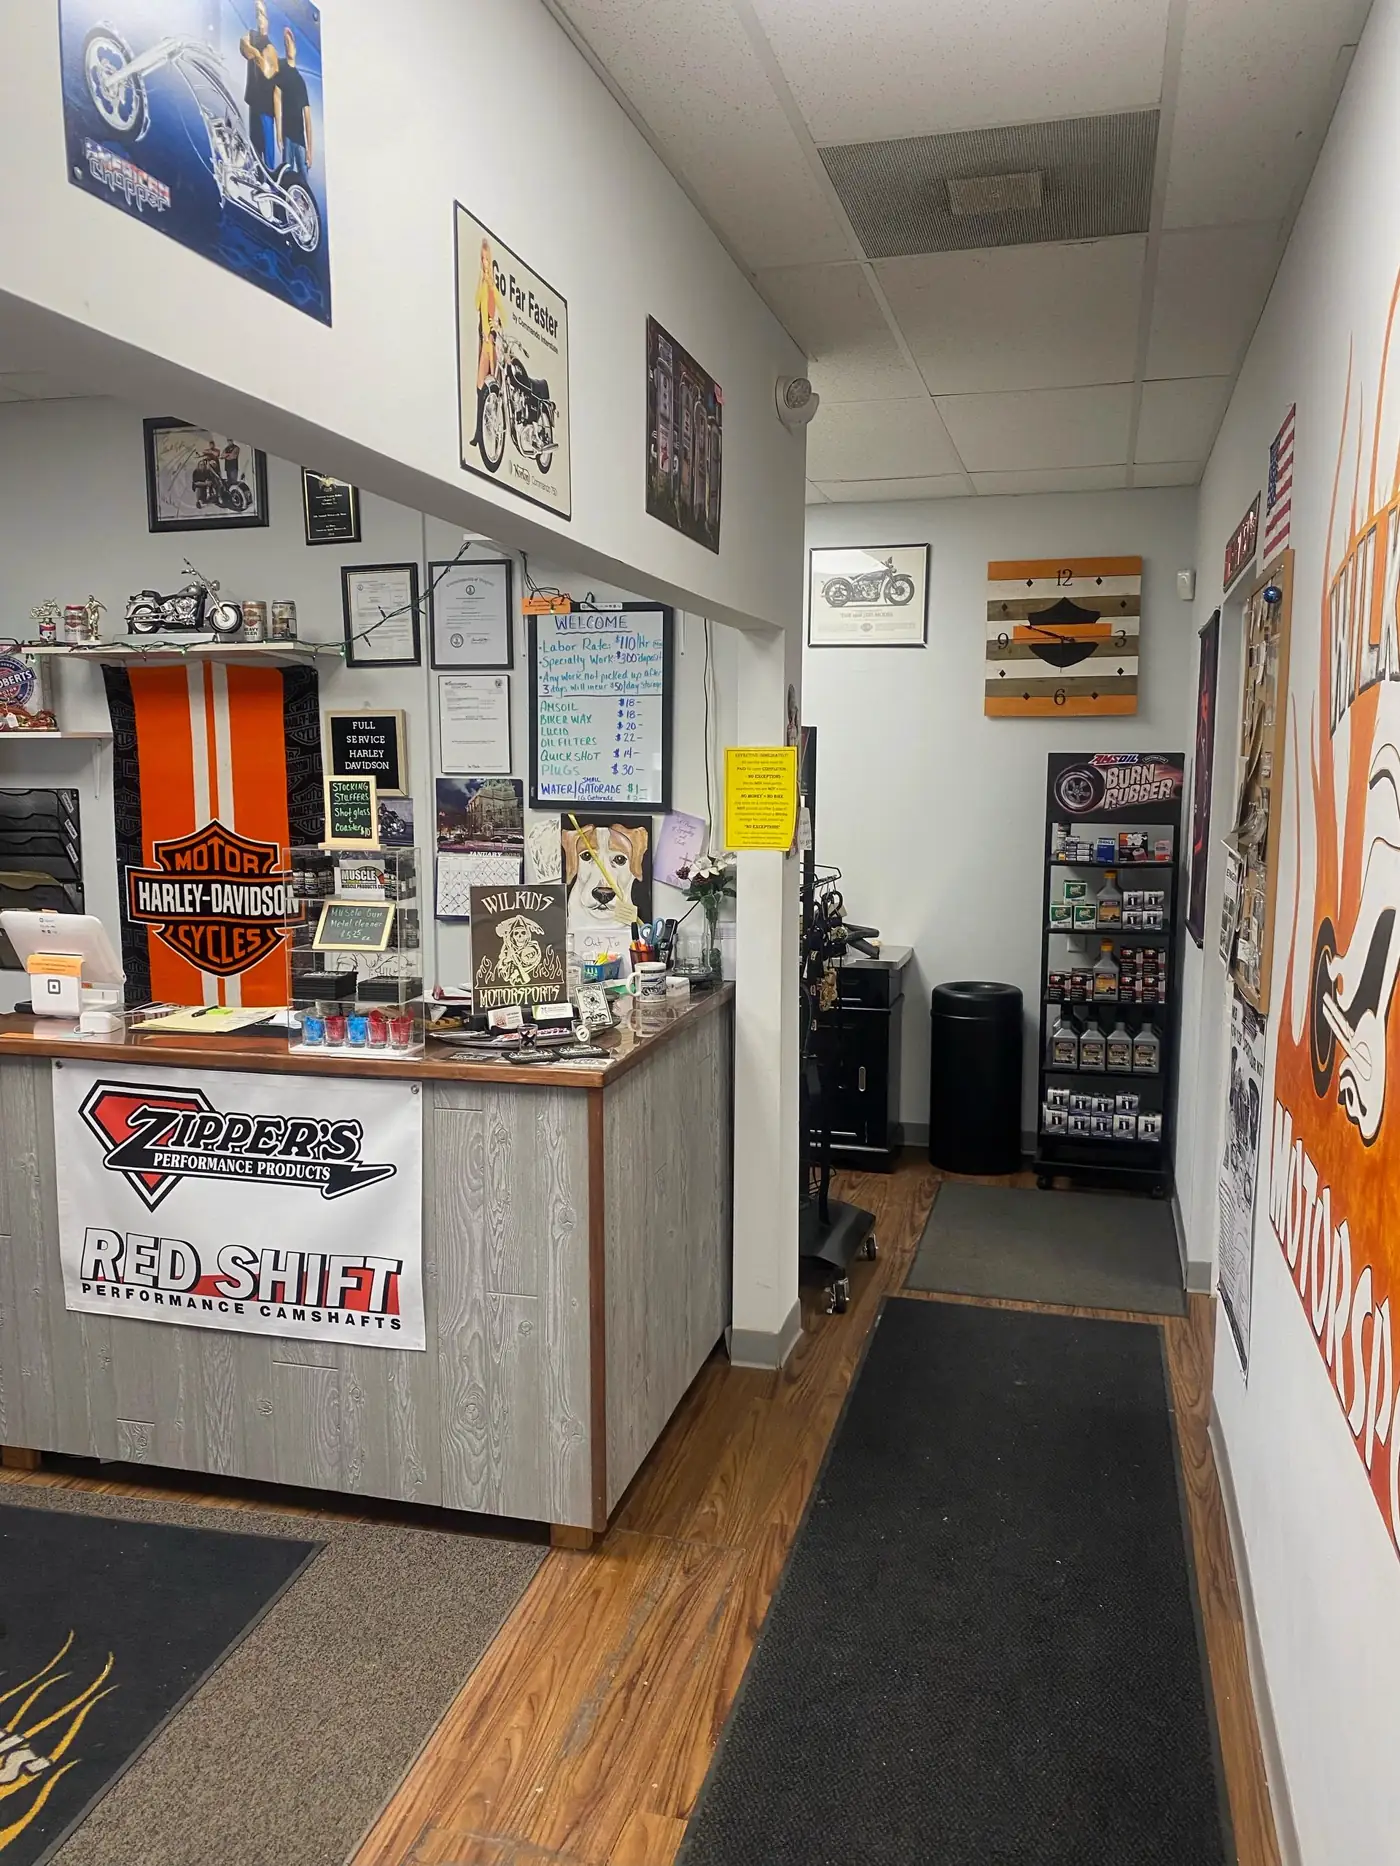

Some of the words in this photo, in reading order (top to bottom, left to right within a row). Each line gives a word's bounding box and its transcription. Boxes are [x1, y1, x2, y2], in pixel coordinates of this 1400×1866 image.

[492, 259, 506, 297] Go
[509, 274, 526, 313] Far
[528, 290, 558, 339] Faster
[1056, 567, 1073, 587] 12
[555, 615, 628, 631] WELCOME
[543, 639, 577, 653] Labor
[997, 632, 1010, 650] 9
[1114, 630, 1126, 648] 3
[542, 654, 585, 673] Specialty
[584, 670, 598, 680] not
[601, 669, 628, 683] picked
[631, 671, 642, 681] up
[543, 684, 550, 694] 3
[1054, 688, 1066, 706] 6
[540, 700, 578, 713] AMSOIL
[352, 721, 376, 730] FULL
[540, 714, 568, 725] BIKER
[571, 714, 592, 724] WAX
[346, 735, 386, 744] SERVICE
[540, 738, 555, 748] OIL
[558, 736, 598, 747] FILTERS
[349, 749, 385, 758] HARLEY
[574, 751, 602, 761] SHOT
[1091, 753, 1139, 766] AMSOIL
[344, 761, 390, 770] DAVIDSON
[1106, 763, 1155, 789] BURN
[332, 782, 369, 792] STOCKING
[1103, 779, 1173, 810] RUBBER
[334, 792, 370, 802] STUFFERS
[334, 807, 352, 818] Shot
[353, 807, 371, 820] glass
[335, 823, 361, 832] Coaster
[174, 837, 259, 874] MOTOR
[341, 869, 377, 881] MUSCLE
[138, 881, 299, 916] HARLEY-DAVIDSON
[481, 891, 555, 915] WILKINS
[179, 924, 262, 964] CYCLES
[583, 936, 603, 947] Out
[604, 936, 620, 948] To
[479, 985, 560, 1008] MOTORSPORTS
[108, 1105, 364, 1165] ZIPPER'S
[152, 1152, 253, 1175] PERFORMANCE
[257, 1161, 331, 1181] PRODUCTS
[81, 1227, 202, 1292] RED
[214, 1243, 403, 1315] SHIFT
[82, 1282, 245, 1315] PERFORMANCE
[260, 1305, 402, 1331] CAMSHAFTS
